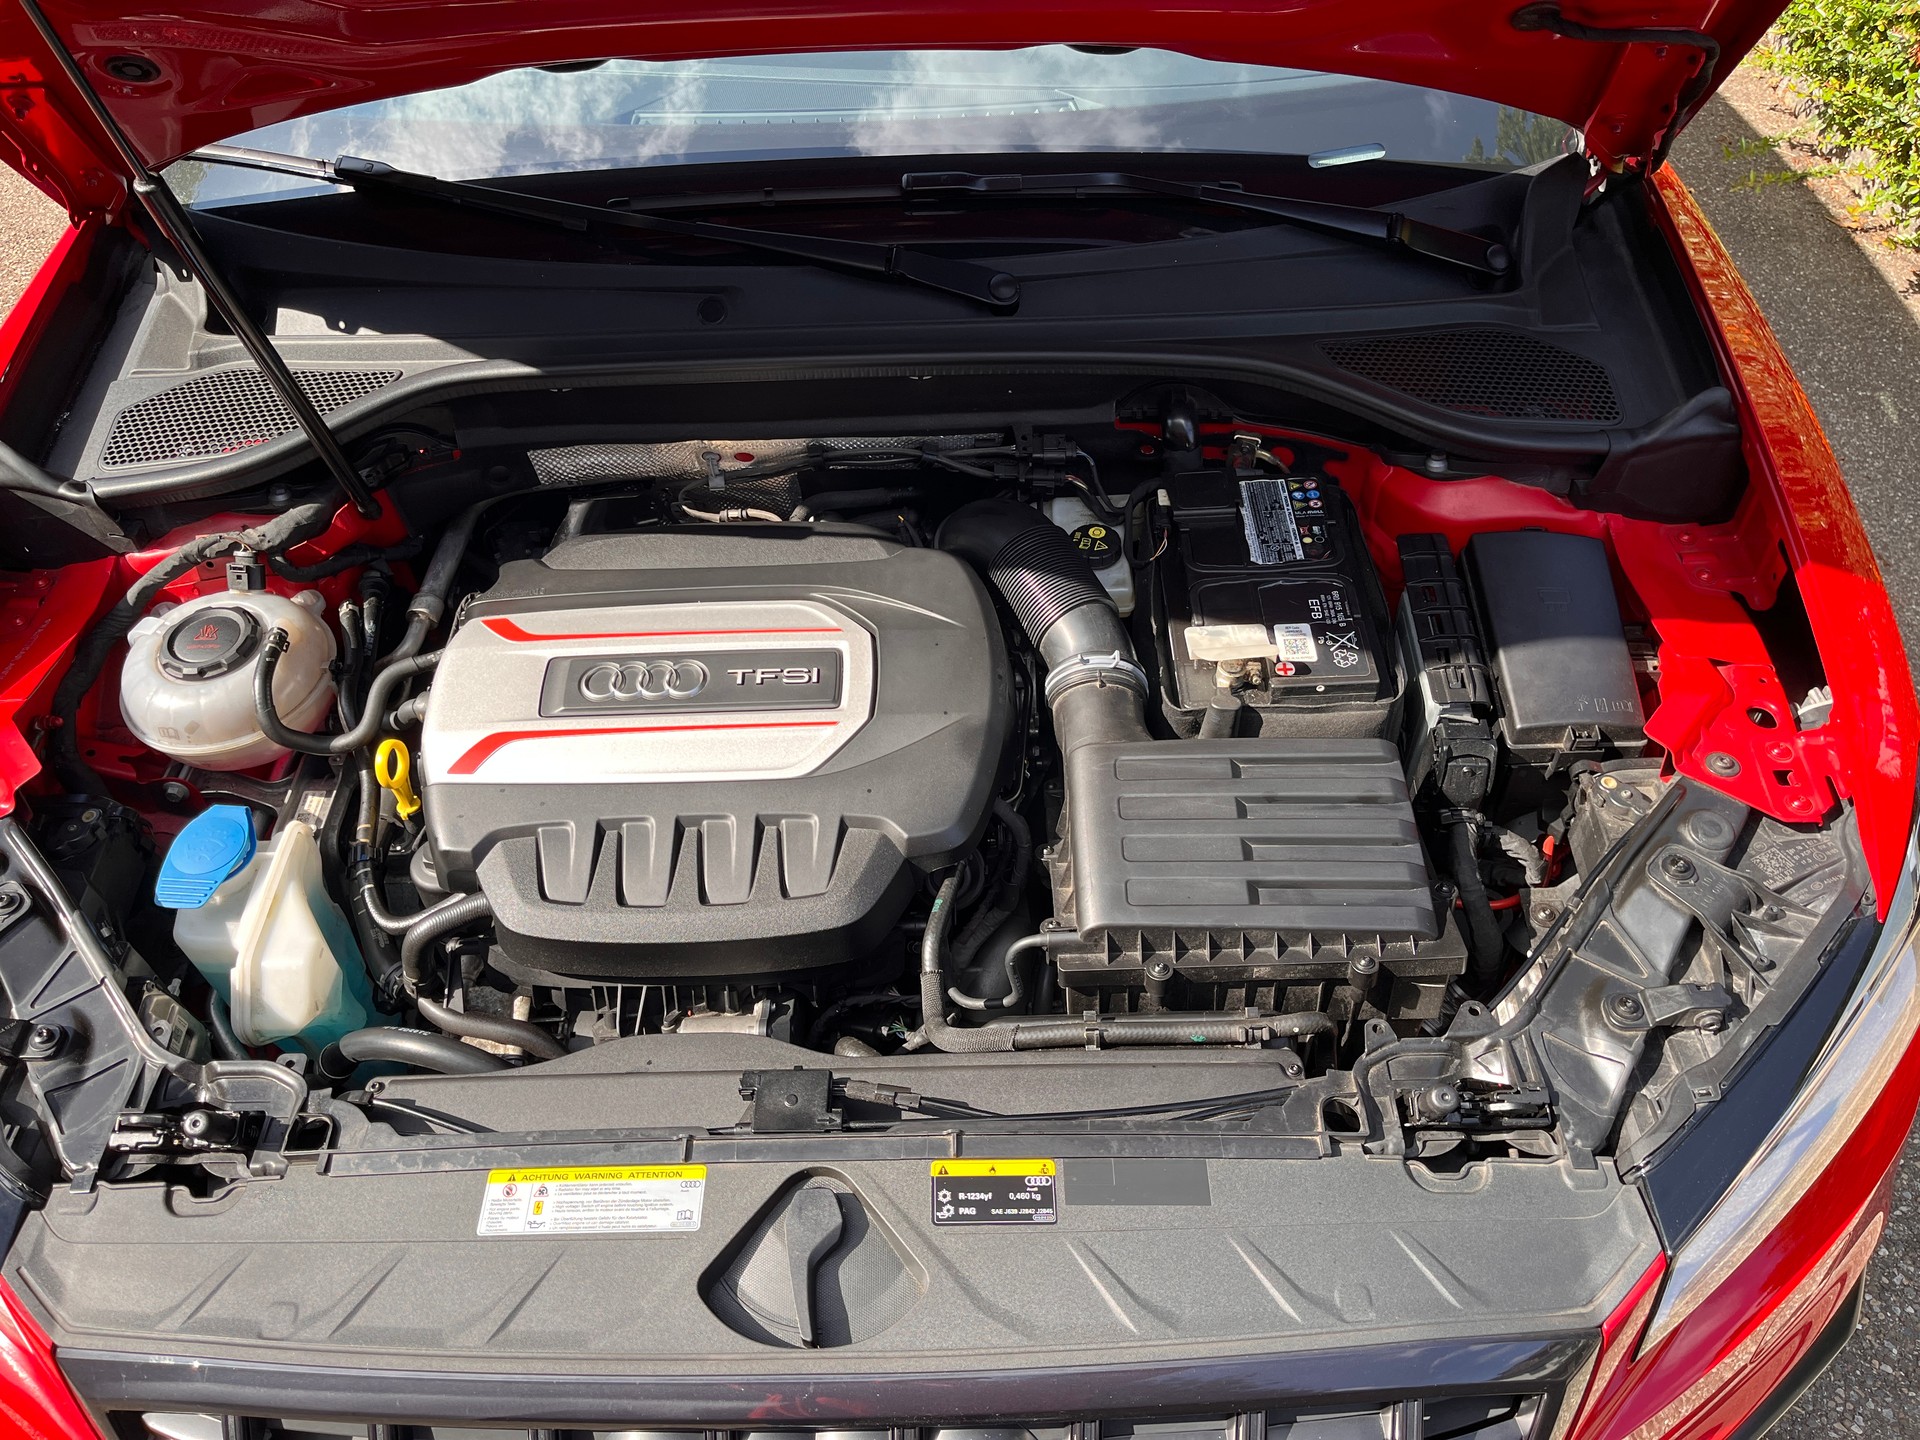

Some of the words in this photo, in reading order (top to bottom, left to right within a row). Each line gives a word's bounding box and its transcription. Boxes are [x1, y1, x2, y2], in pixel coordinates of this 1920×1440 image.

[1308, 600, 1322, 619] EFB
[727, 667, 820, 685] TFSI
[574, 1172, 622, 1180] WARNING
[628, 1171, 683, 1179] ATTENTION
[959, 1193, 992, 1201] R-1234yf
